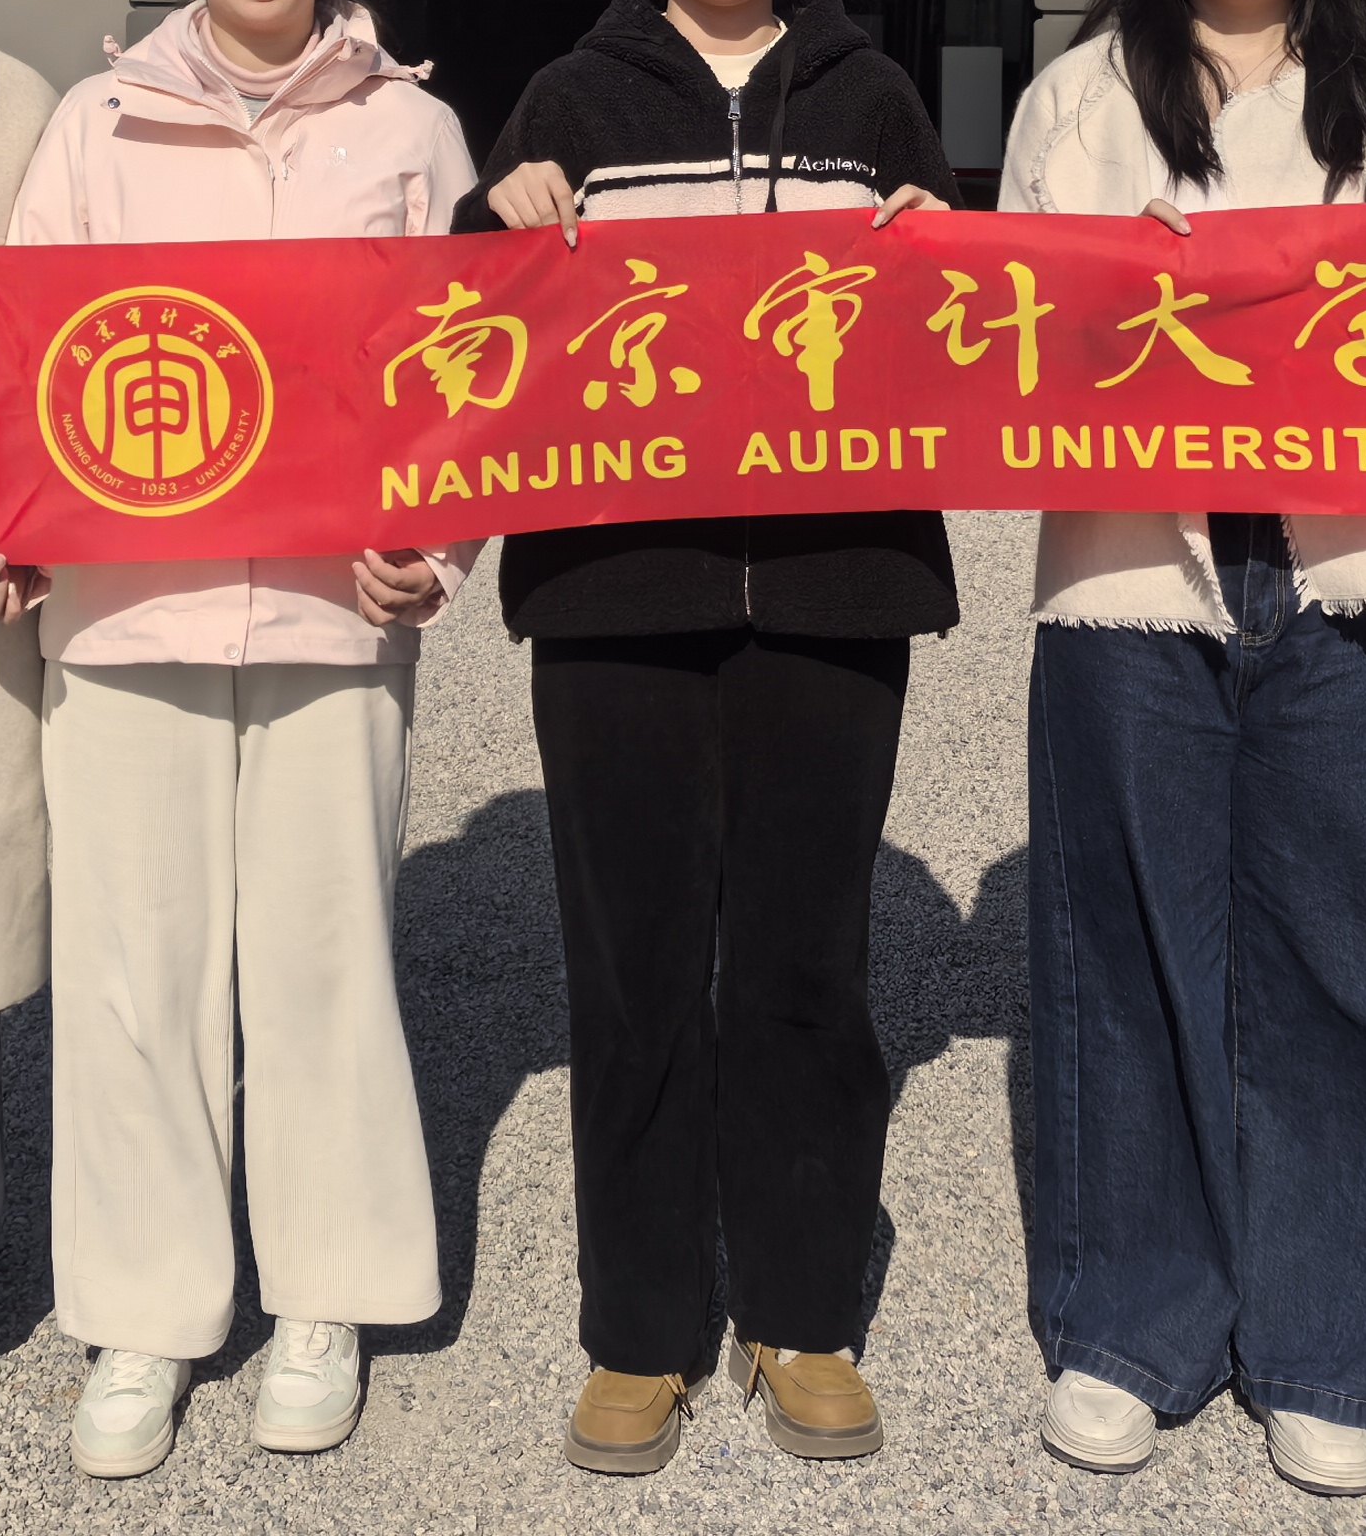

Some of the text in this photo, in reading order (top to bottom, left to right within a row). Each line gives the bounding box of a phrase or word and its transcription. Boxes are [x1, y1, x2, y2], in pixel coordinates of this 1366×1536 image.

[71, 306, 241, 367] 南京审计大学
[61, 412, 90, 466] NANJING
[88, 463, 125, 491] AUDIT
[195, 409, 251, 487] UNIVERSITY
[381, 435, 687, 510] NANJING
[736, 424, 948, 474] AUDIT
